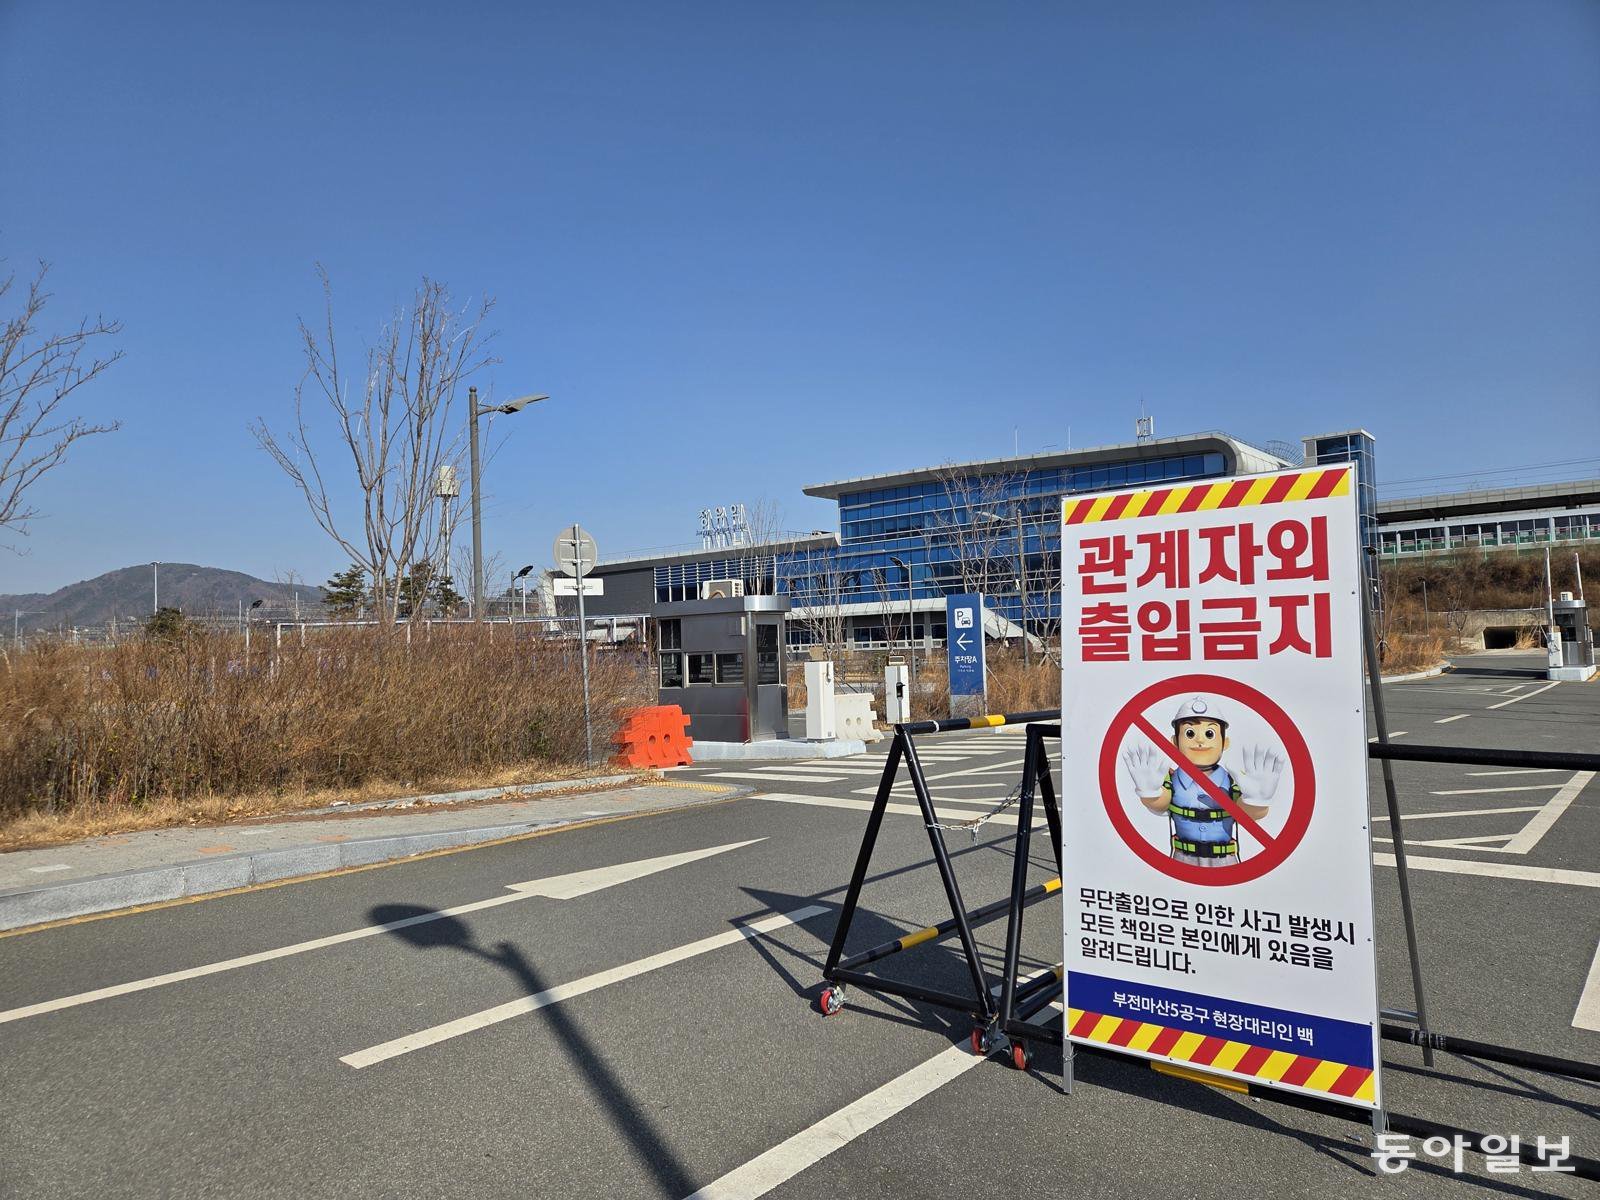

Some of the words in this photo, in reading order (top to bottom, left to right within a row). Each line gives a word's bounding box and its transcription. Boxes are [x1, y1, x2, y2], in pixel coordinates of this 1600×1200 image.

[1078, 516, 1330, 595] 관계자외
[1078, 592, 1333, 662] 출입금지
[955, 656, 977, 664] 주차장A
[1080, 887, 1189, 922] 무단출입으로
[1195, 903, 1235, 929] 인한
[1240, 908, 1281, 934] 사고
[1288, 914, 1355, 946] 발생시
[1081, 912, 1115, 936] 모든
[1120, 918, 1175, 945] 책임은
[1181, 927, 1261, 959] 본인에게
[1268, 939, 1334, 971] 있음을
[1081, 937, 1197, 974] 알려드립니다.
[1112, 991, 1210, 1024] 부전마산5공구
[1212, 1009, 1293, 1042] 현장대리인
[1297, 1027, 1314, 1046] 백
